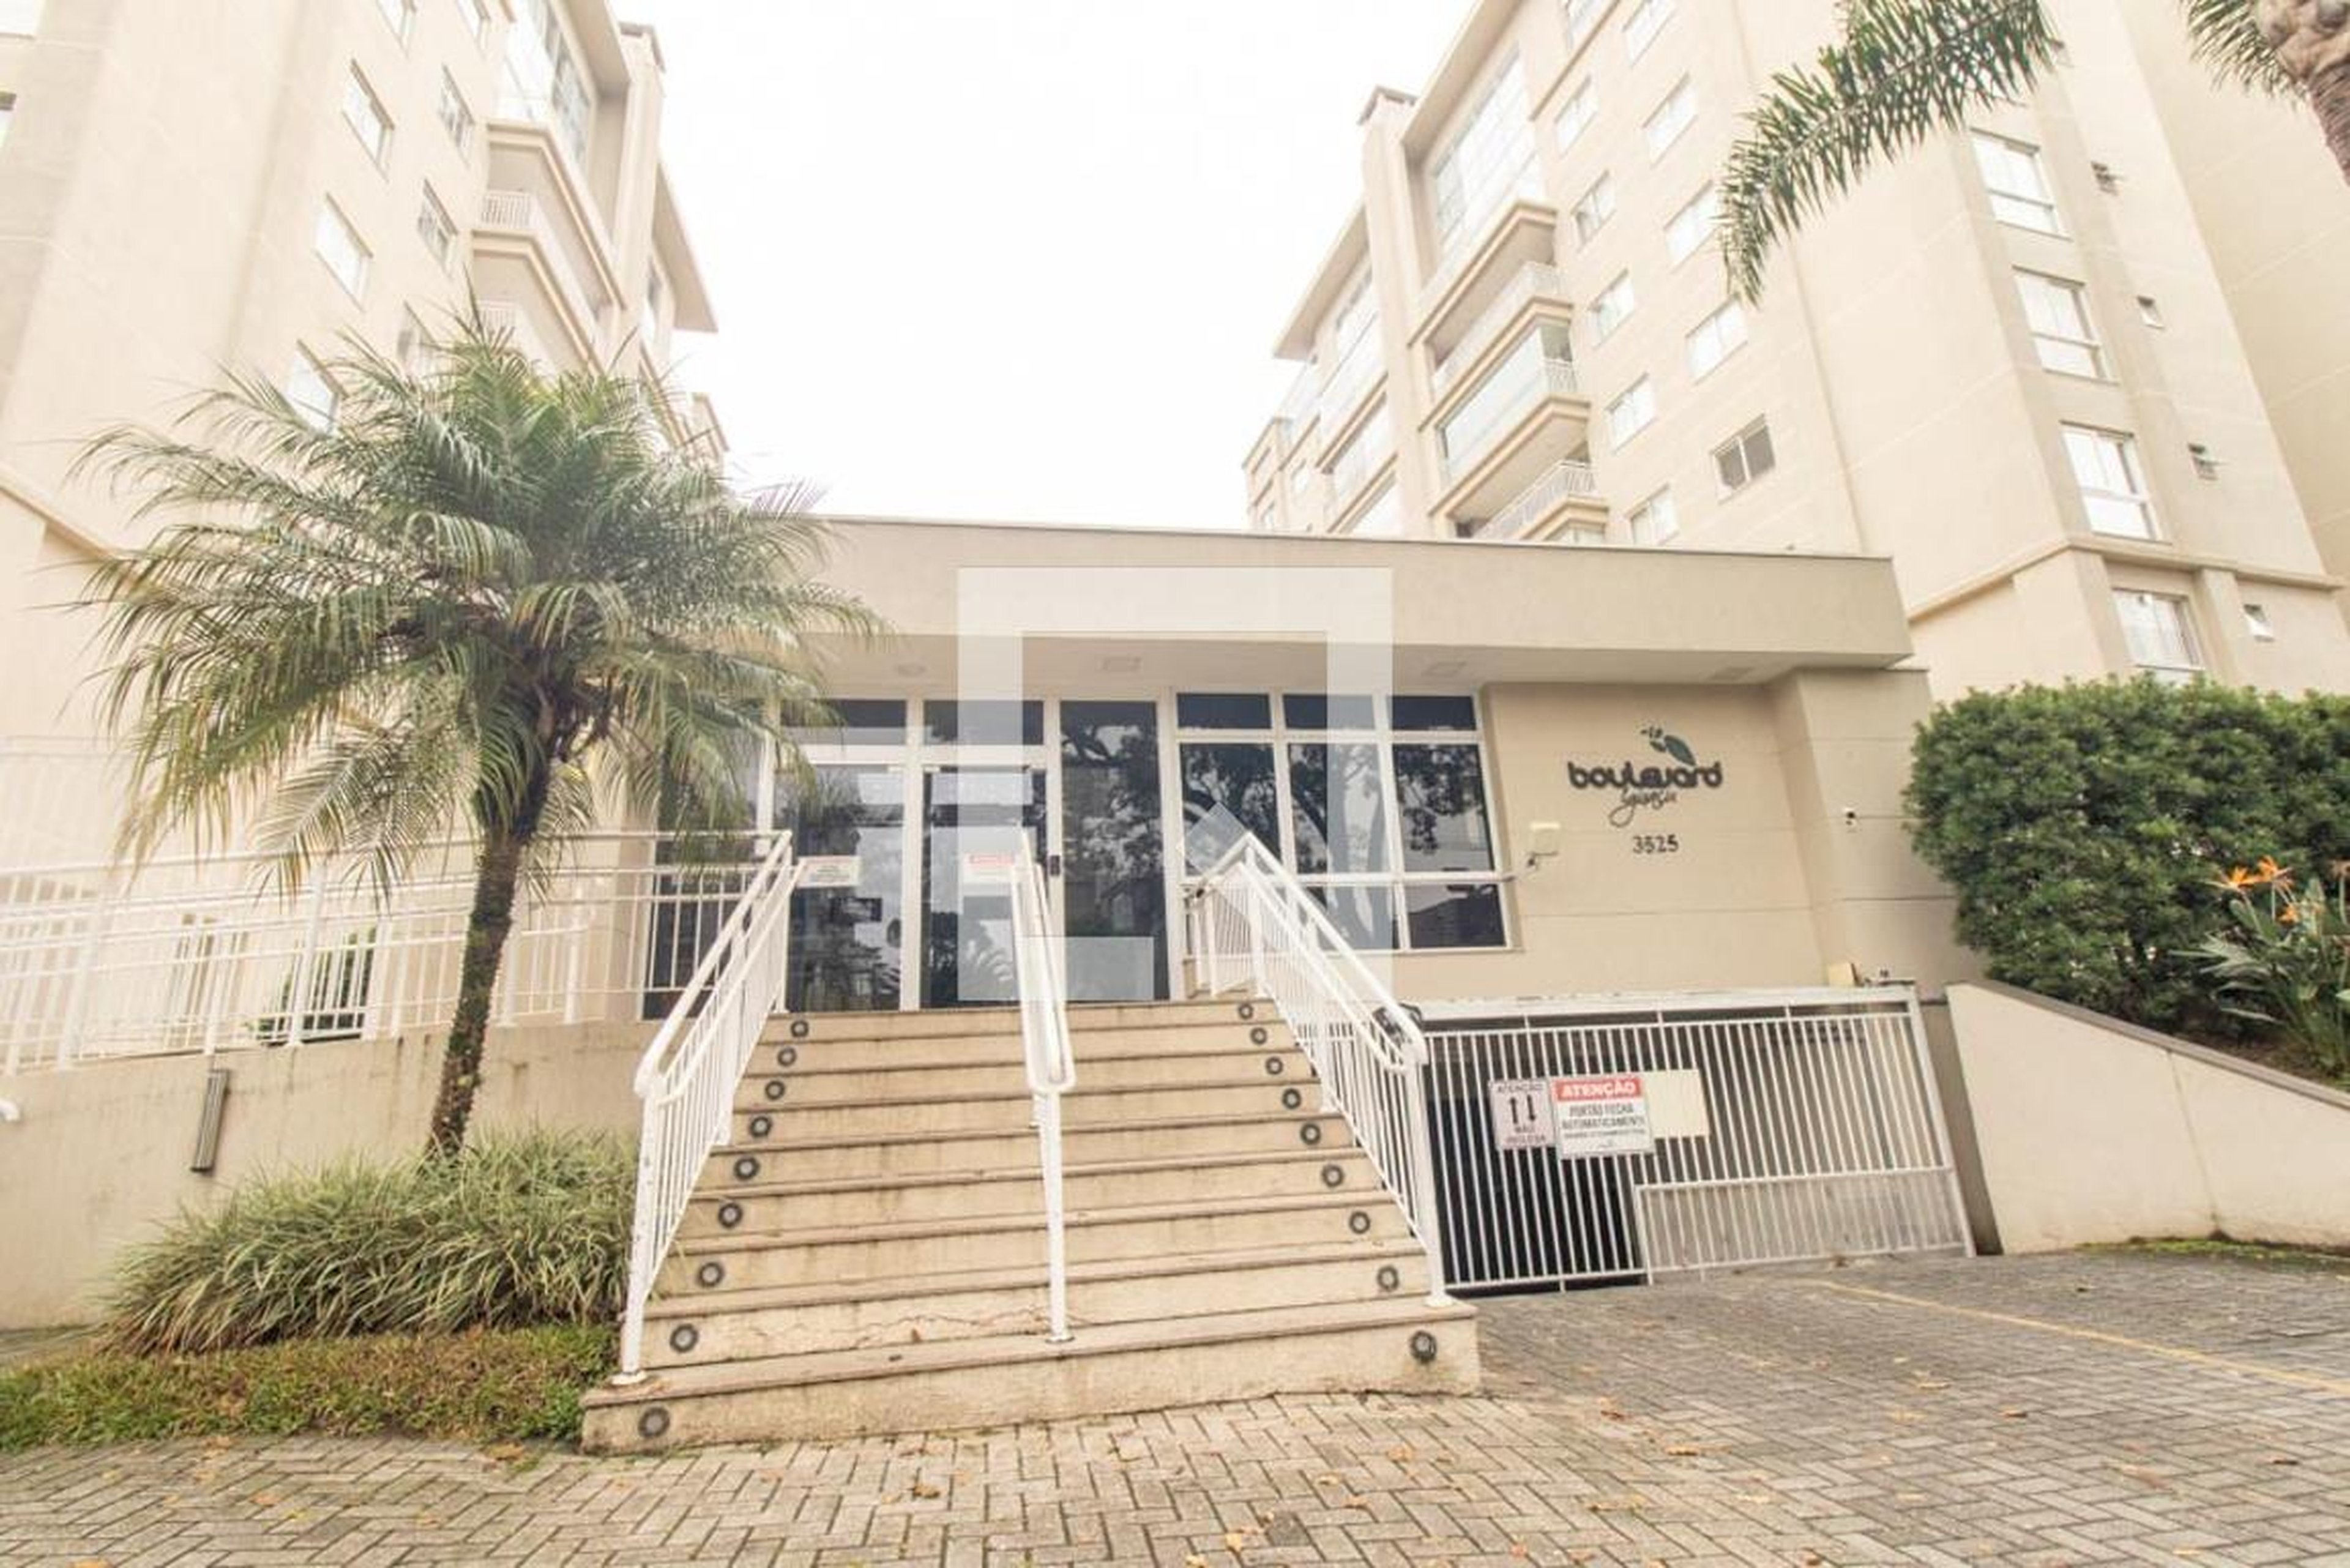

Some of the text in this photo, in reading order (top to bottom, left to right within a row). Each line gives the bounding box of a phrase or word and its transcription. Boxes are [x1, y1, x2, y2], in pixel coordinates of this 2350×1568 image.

[1567, 761, 1723, 788] boulevard
[1632, 834, 1679, 853] 3525
[1561, 1080, 1637, 1097] ATENÇÃO
